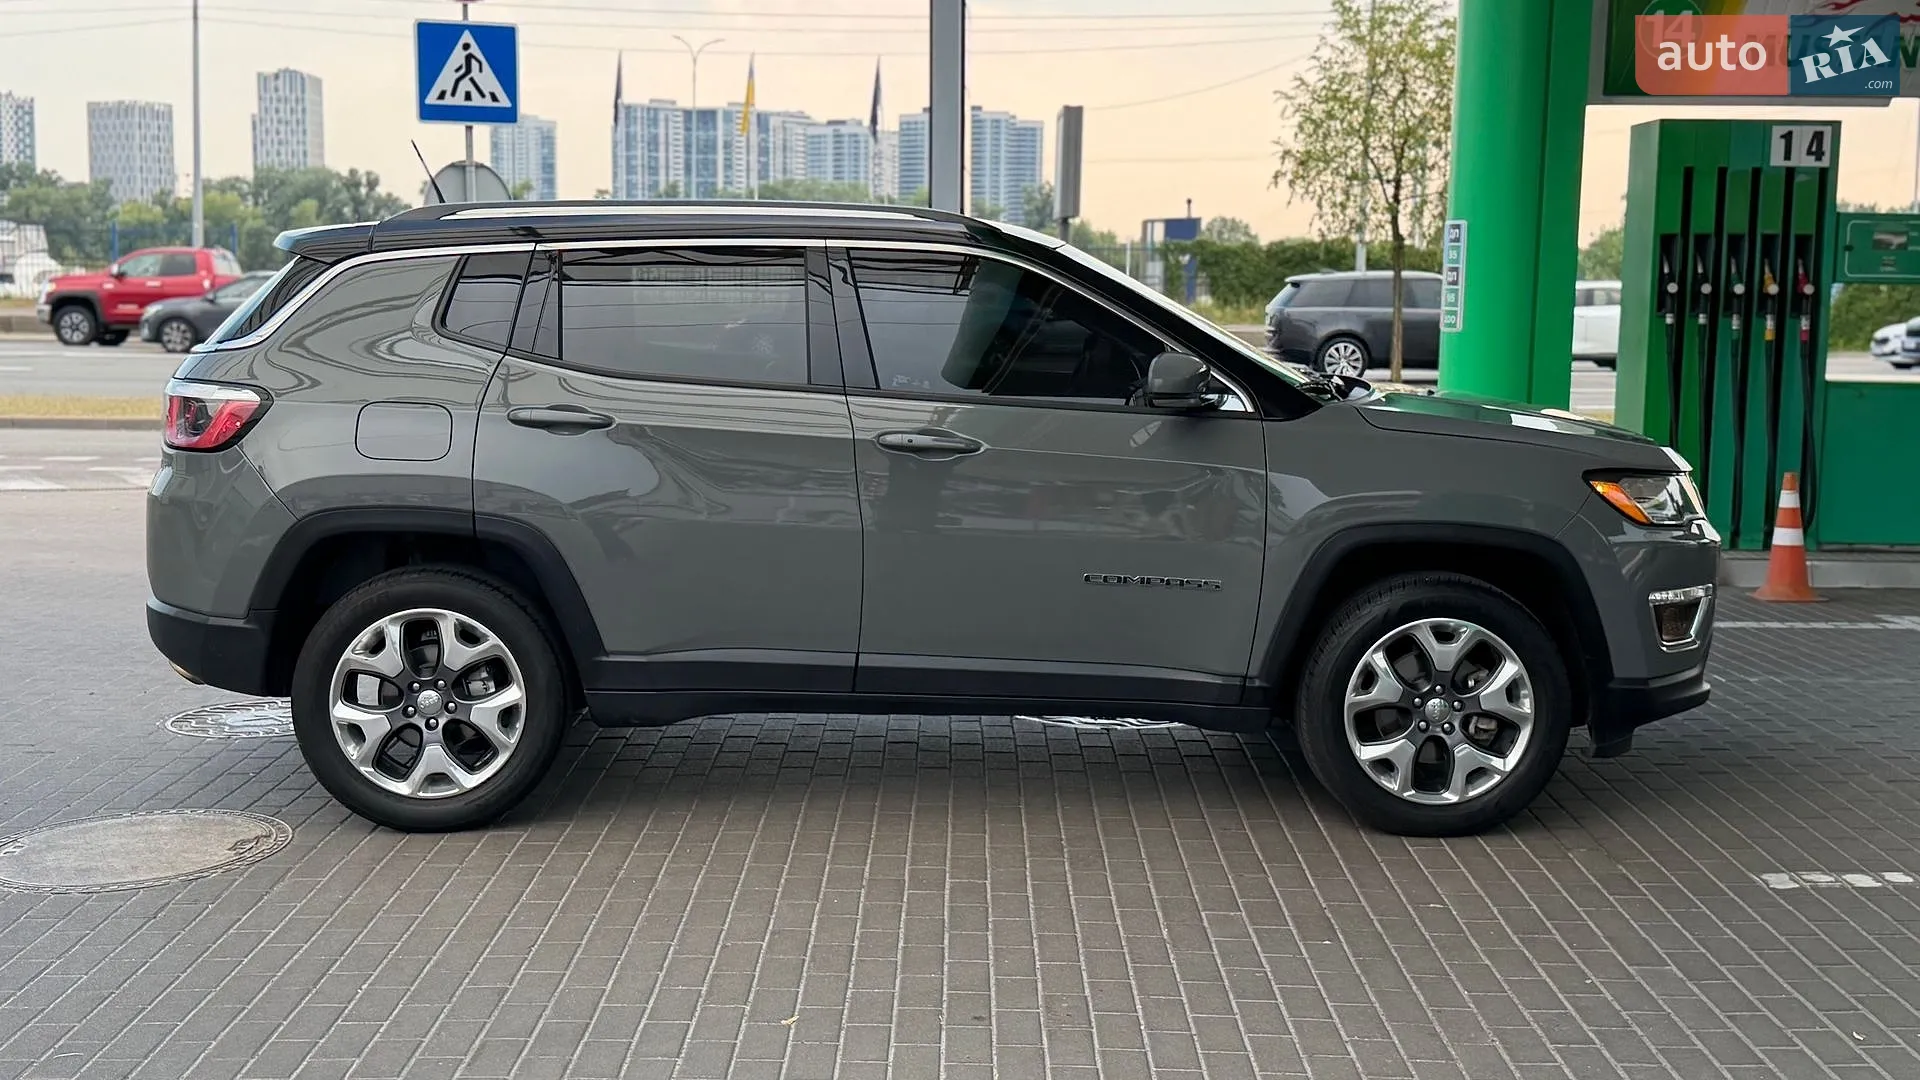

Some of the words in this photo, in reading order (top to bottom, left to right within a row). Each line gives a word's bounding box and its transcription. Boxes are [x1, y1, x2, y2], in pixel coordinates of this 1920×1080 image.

[1645, 9, 1696, 48] 14
[1779, 130, 1826, 162] 14
[1083, 573, 1222, 589] COMPASS
